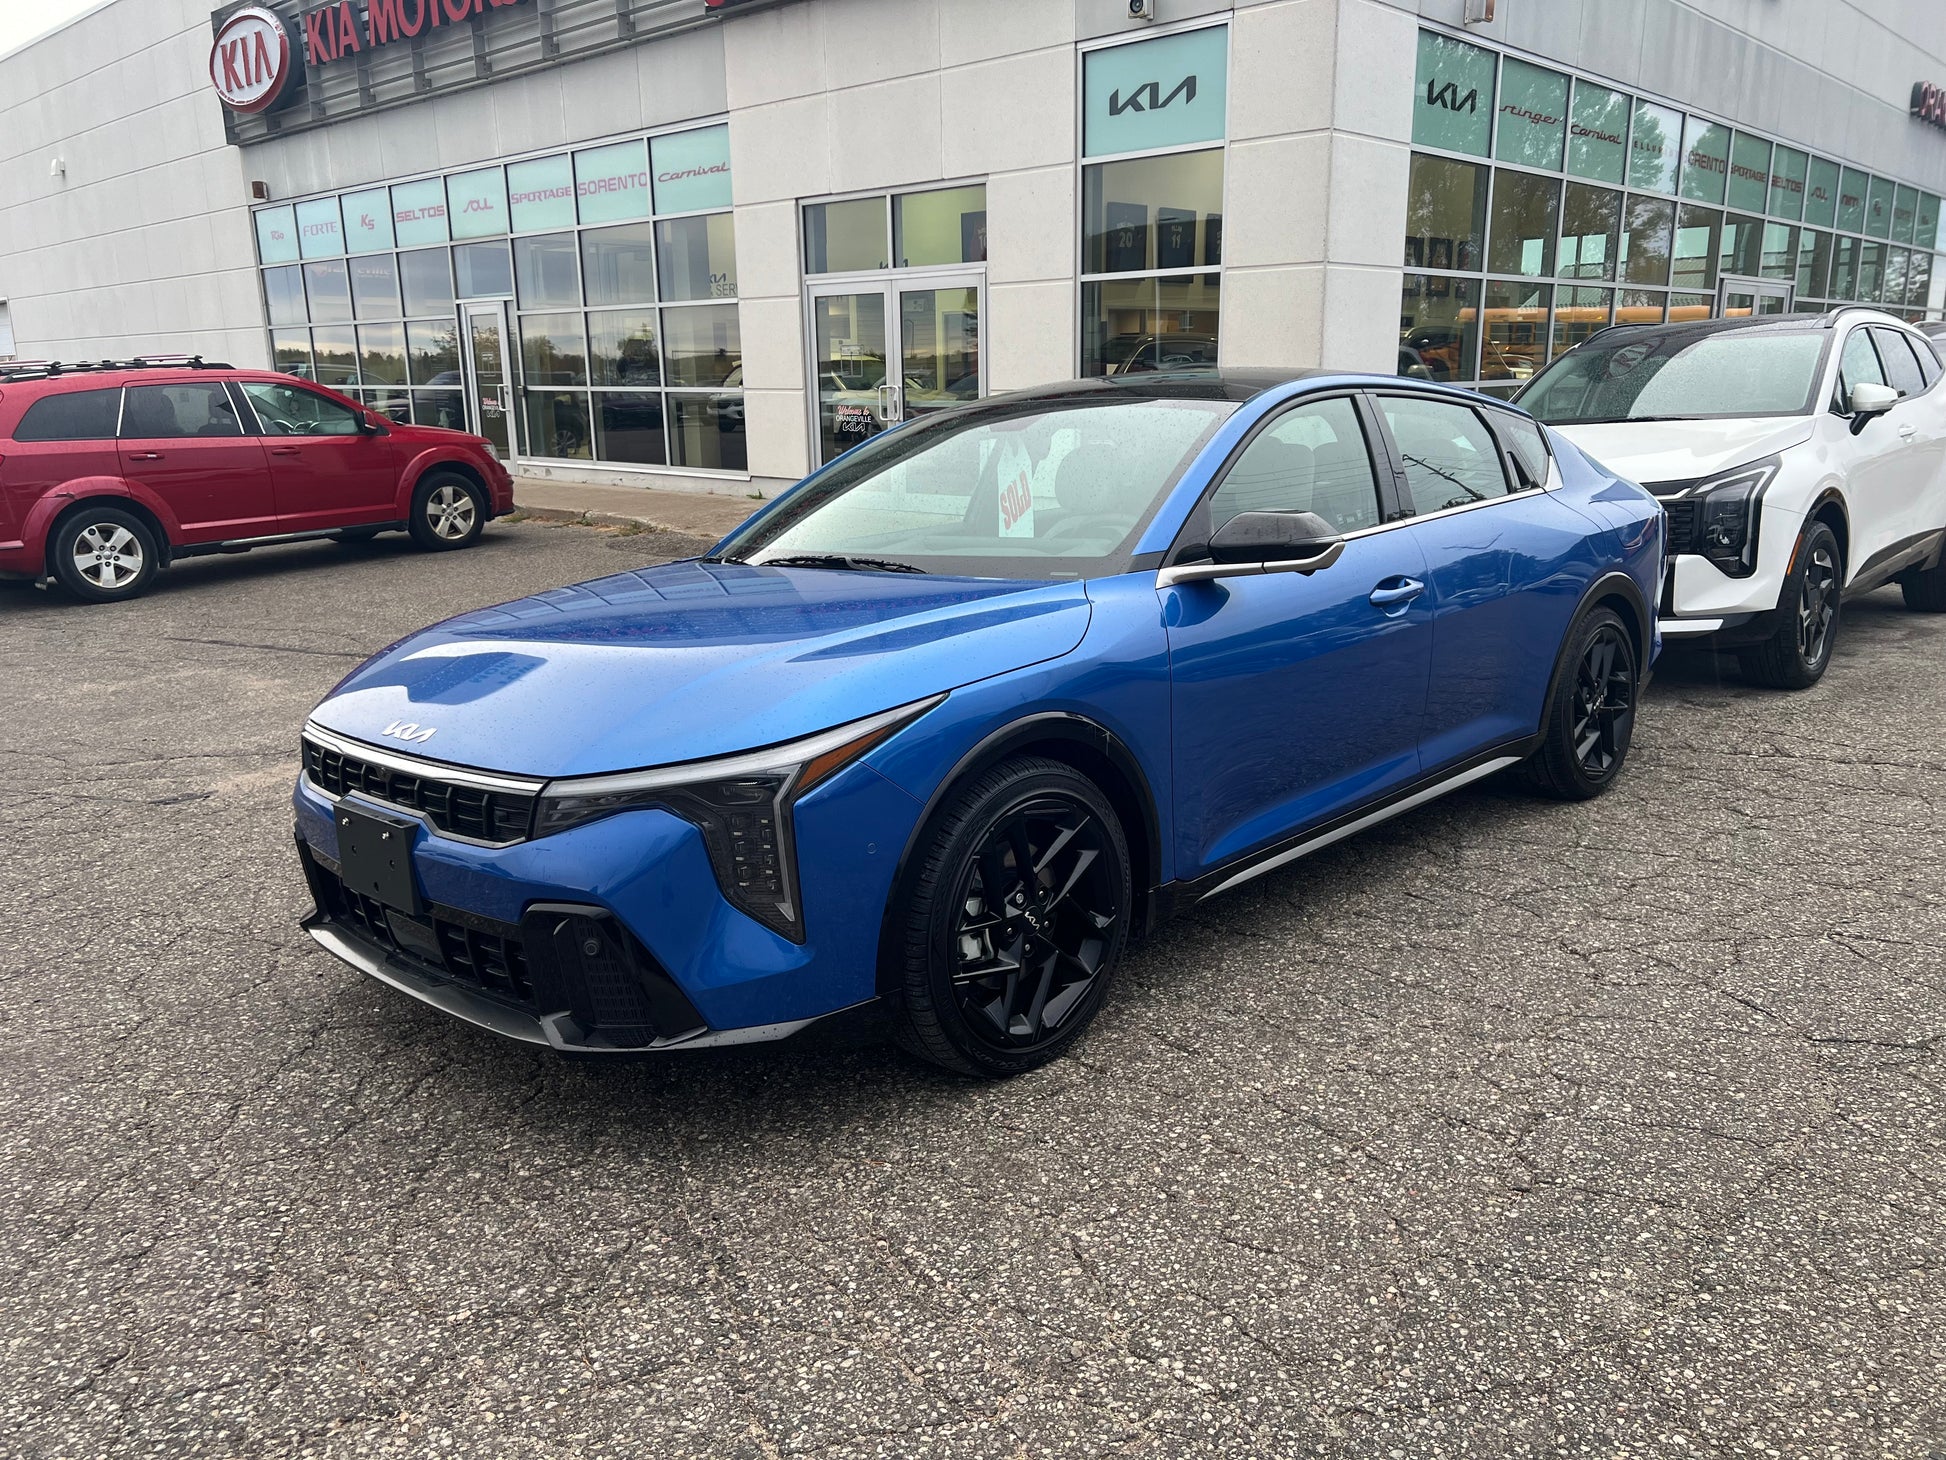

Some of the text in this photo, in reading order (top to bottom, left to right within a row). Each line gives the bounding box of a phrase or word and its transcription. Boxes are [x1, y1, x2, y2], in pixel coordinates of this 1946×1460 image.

[306, 0, 518, 65] KIA MOT
[220, 32, 274, 92] KIA
[1109, 75, 1197, 116] KIA
[1426, 78, 1478, 114] KIA
[1570, 124, 1622, 145] Carnival
[657, 161, 731, 183] Carnival
[1687, 150, 1726, 174] ORENTO
[511, 187, 572, 204] SPORTAGE
[578, 172, 648, 196] SORENTO
[396, 205, 446, 223] SELTOS
[463, 198, 493, 213] SOUL
[303, 221, 338, 237] FORTE
[835, 414, 872, 423] ORANGEVILLE
[842, 422, 866, 432] KIA
[1000, 470, 1032, 531] SOLD
[382, 719, 438, 744] KIA
